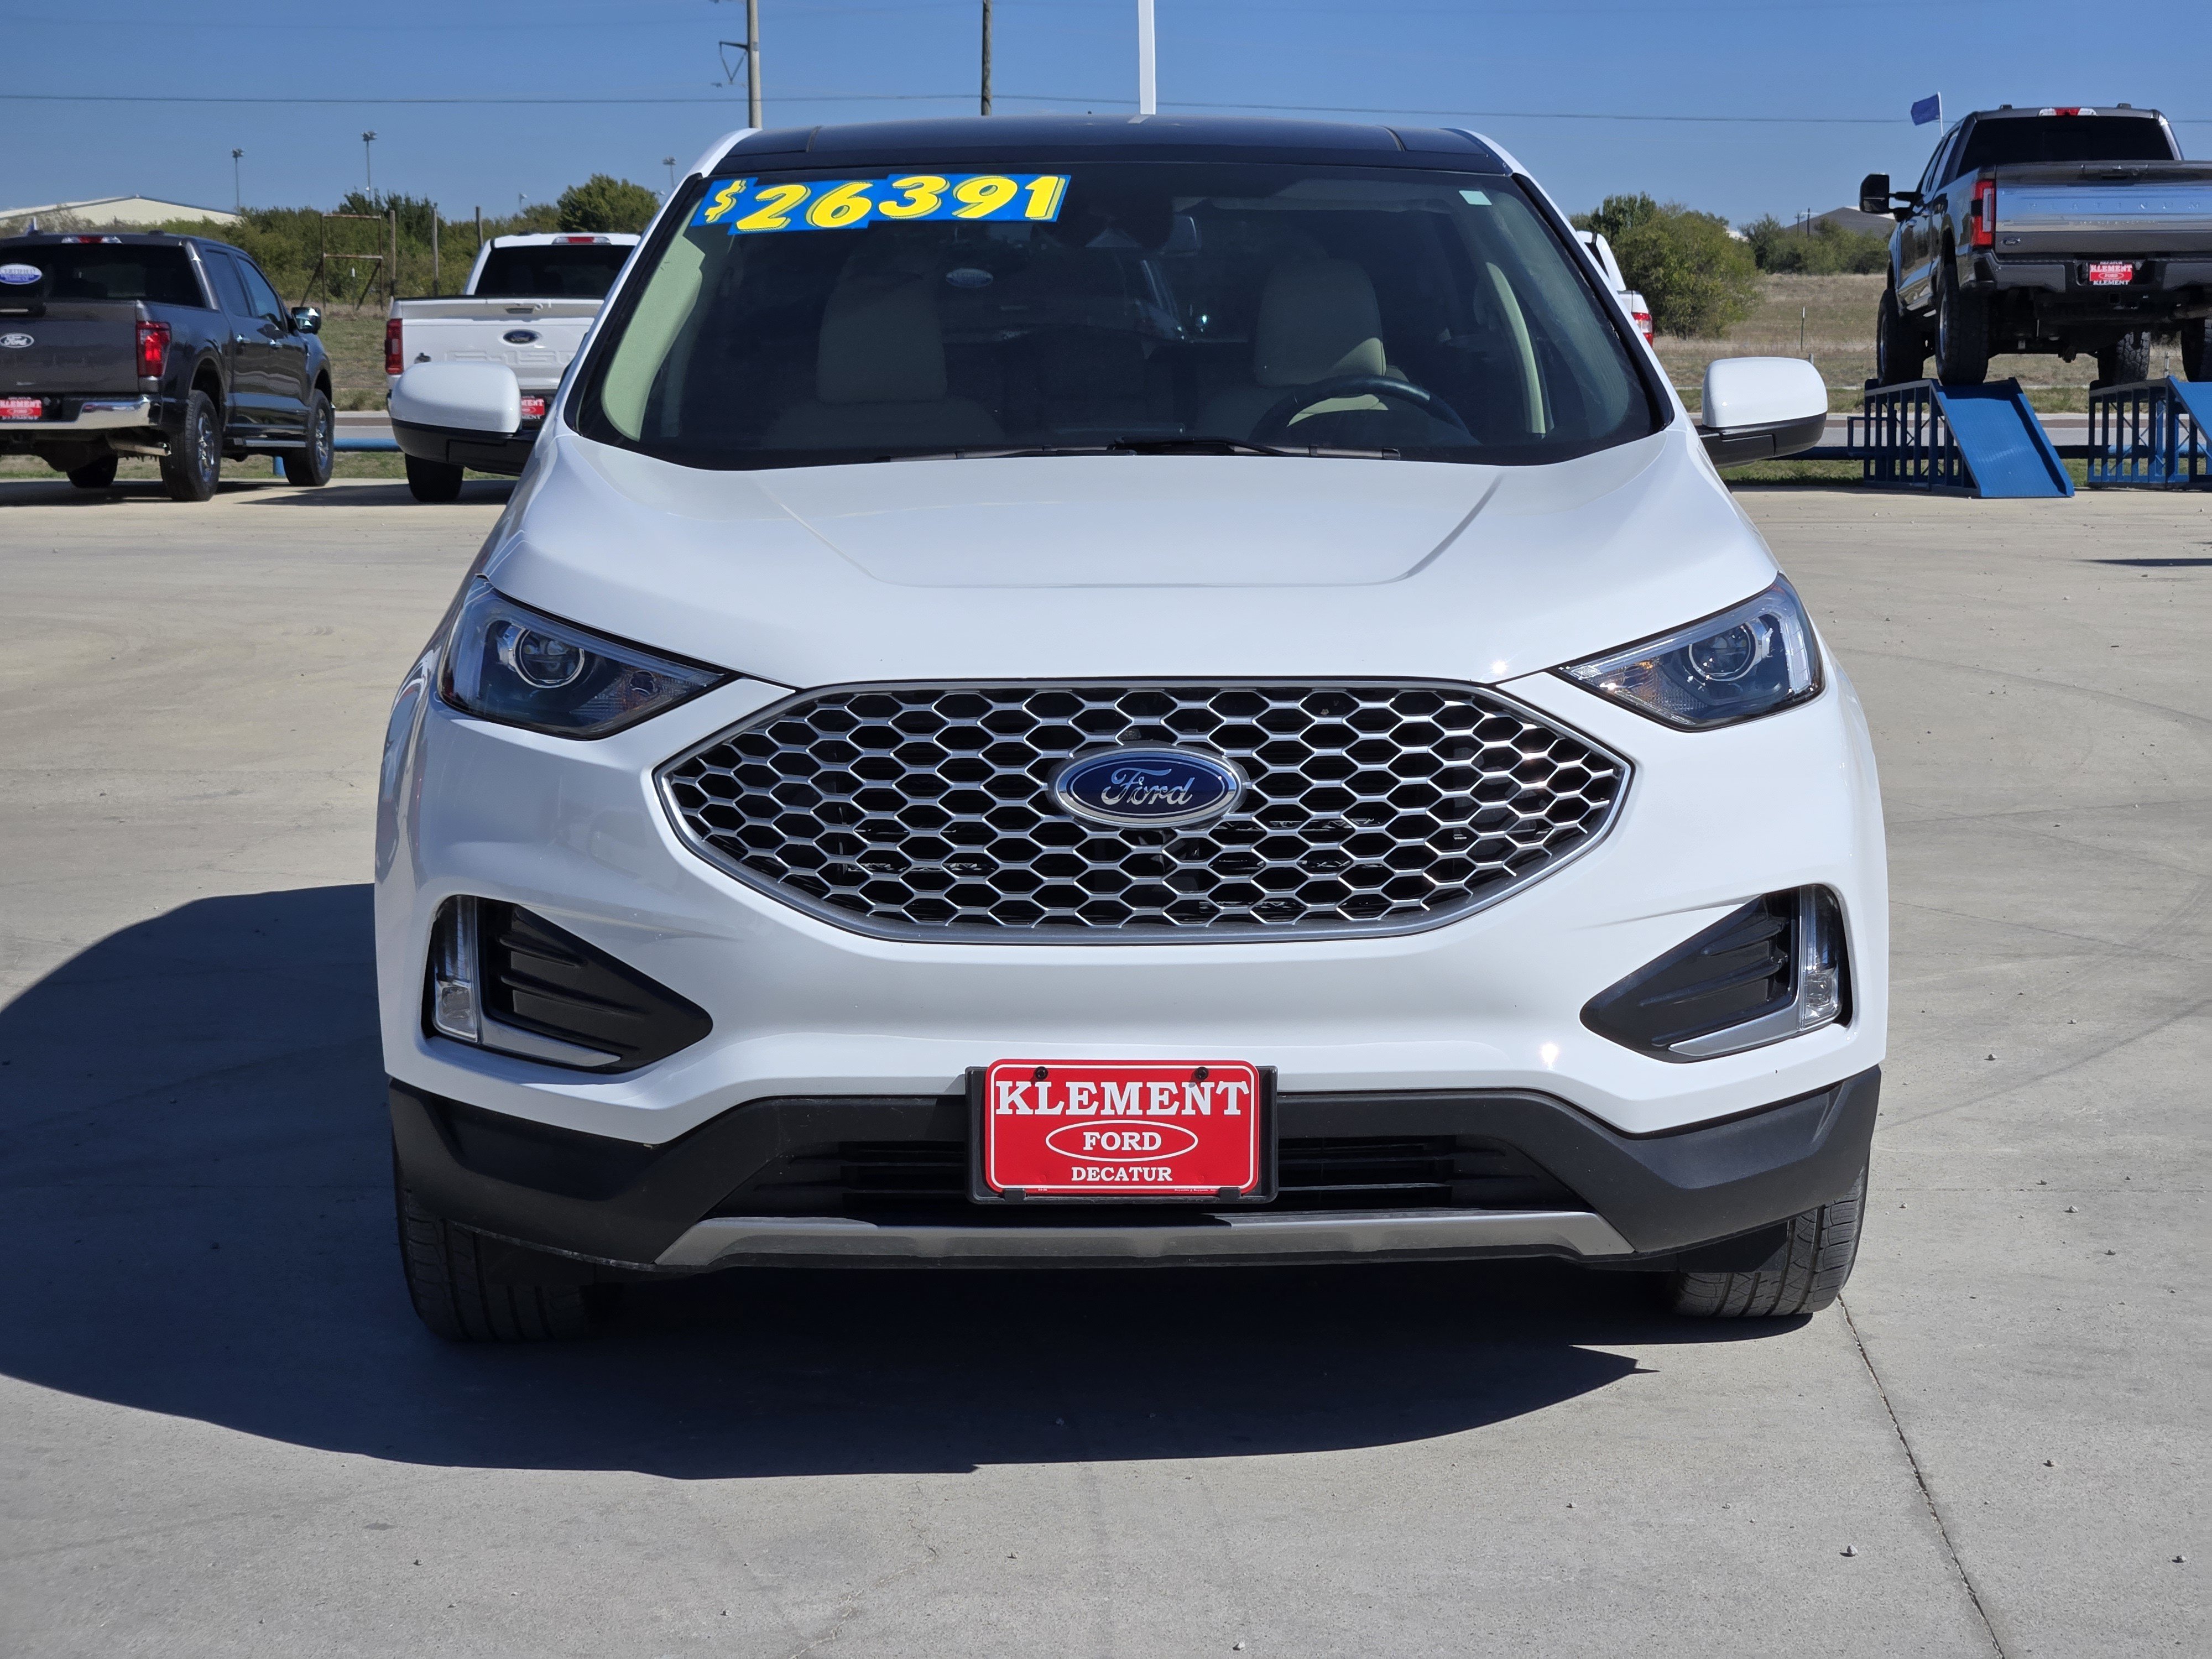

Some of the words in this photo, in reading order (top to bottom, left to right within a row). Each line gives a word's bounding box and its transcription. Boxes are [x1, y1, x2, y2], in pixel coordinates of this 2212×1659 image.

[2090, 264, 2132, 272] KLEMENT
[4, 335, 28, 346] Ford
[1100, 767, 1196, 805] Ford
[995, 1080, 1250, 1116] KLEMENT
[1083, 1131, 1162, 1151] FORD
[1071, 1166, 1173, 1182] DECATUR
